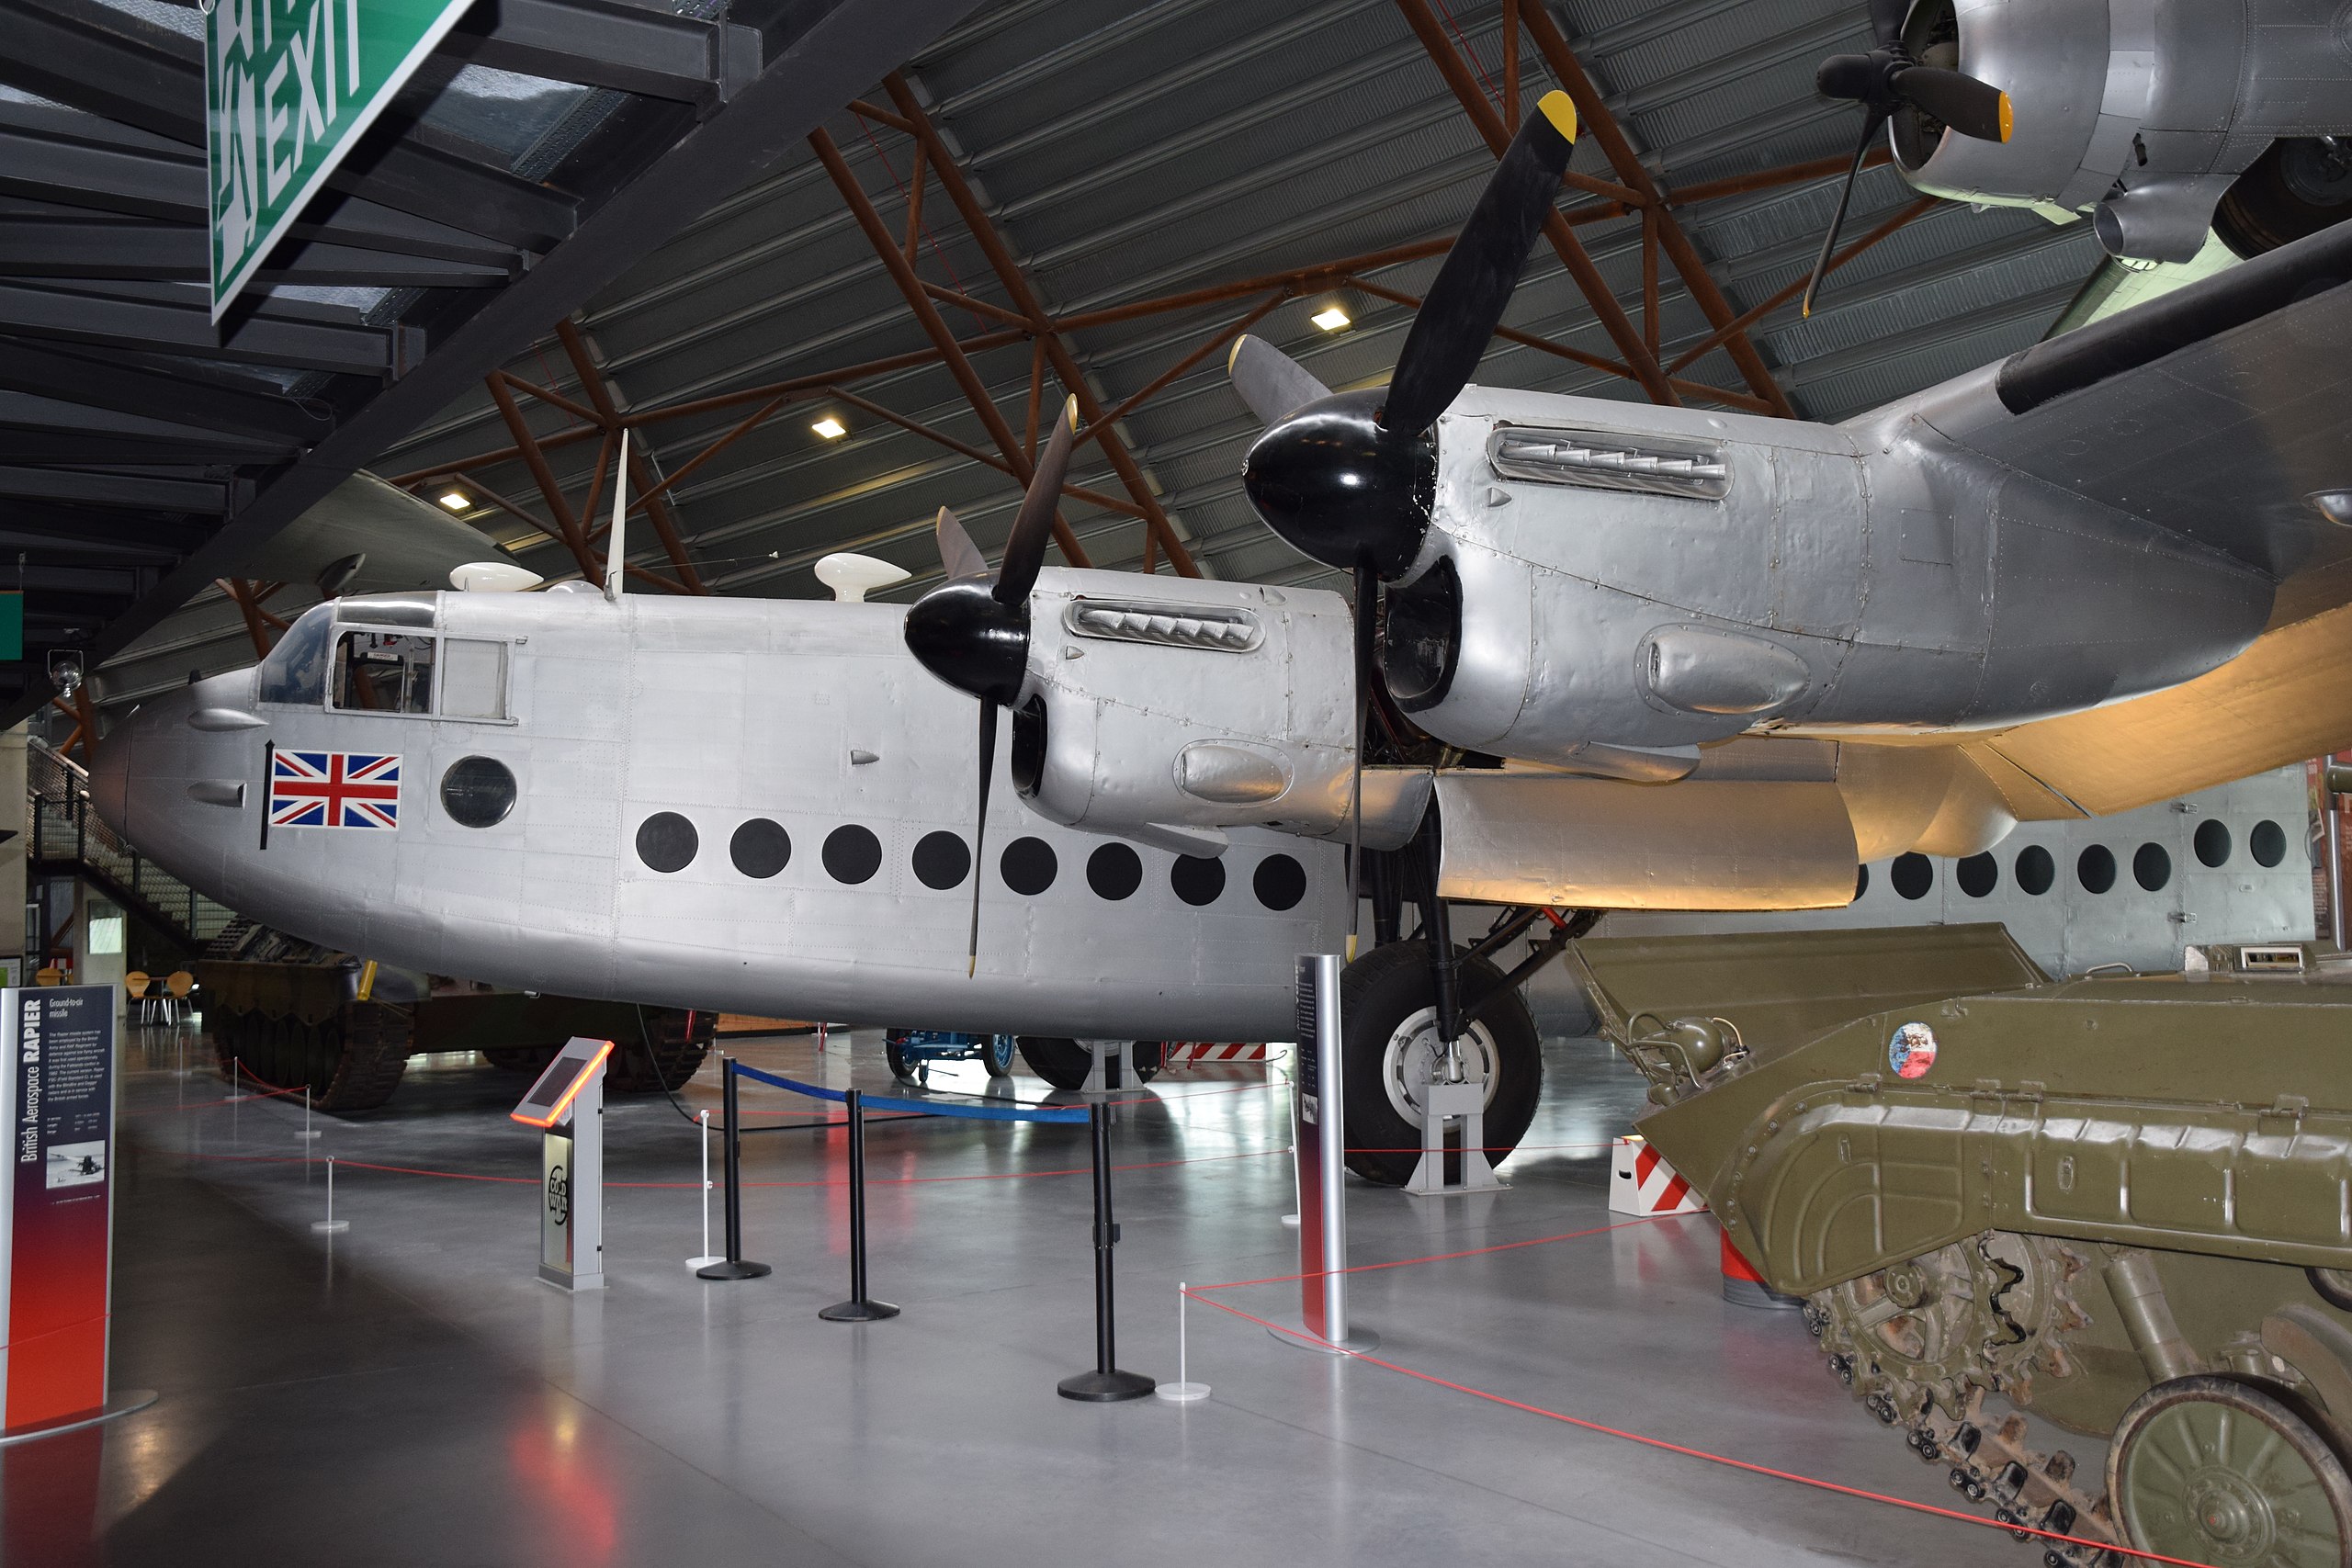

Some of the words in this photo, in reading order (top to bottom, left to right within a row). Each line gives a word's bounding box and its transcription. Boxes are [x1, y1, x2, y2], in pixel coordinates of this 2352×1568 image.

[49, 998, 84, 1008] Ground-to-air
[49, 1008, 68, 1018] missile
[23, 999, 41, 1063] RAPIER
[22, 1066, 42, 1122] Aerospace
[21, 1126, 38, 1162] British
[550, 1178, 567, 1196] COLD
[549, 1193, 568, 1213] WAR
